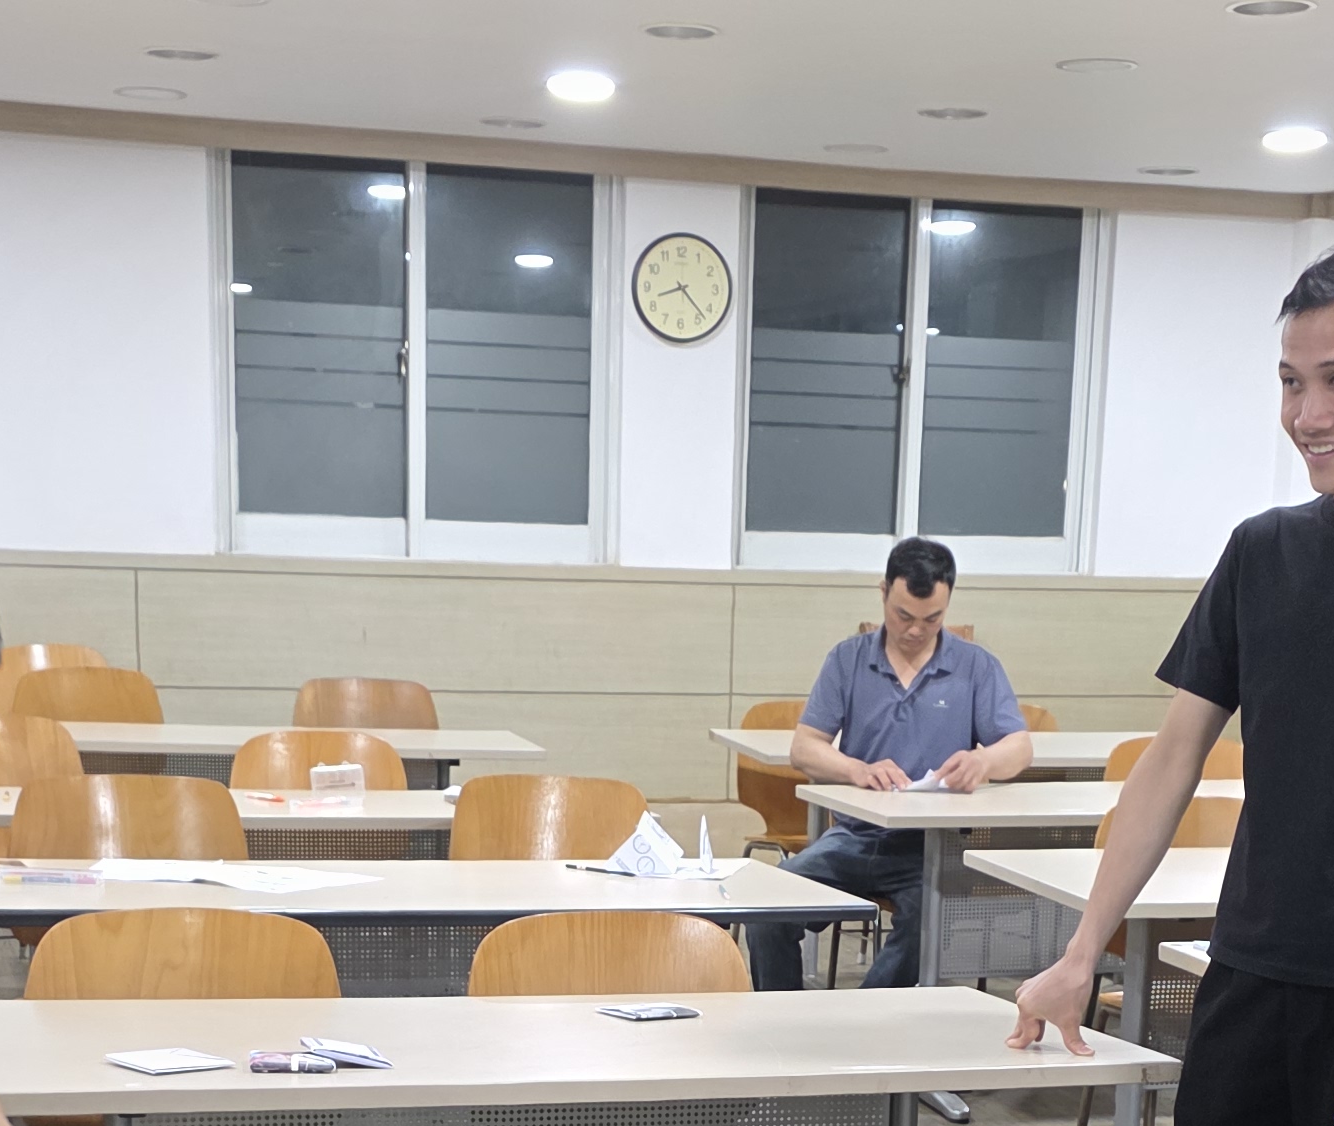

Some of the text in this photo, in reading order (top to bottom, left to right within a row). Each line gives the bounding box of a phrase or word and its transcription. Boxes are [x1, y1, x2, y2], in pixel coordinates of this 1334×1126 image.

[660, 250, 670, 262] 11
[675, 246, 688, 258] 12
[695, 253, 701, 264] 1
[648, 263, 660, 275] 10
[706, 265, 714, 277] 2
[643, 281, 651, 292] 9
[711, 284, 719, 296] 3
[649, 300, 657, 312] 8
[706, 303, 713, 314] 4
[661, 313, 669, 325] 7
[677, 318, 685, 330] 6
[694, 313, 702, 326] 5
